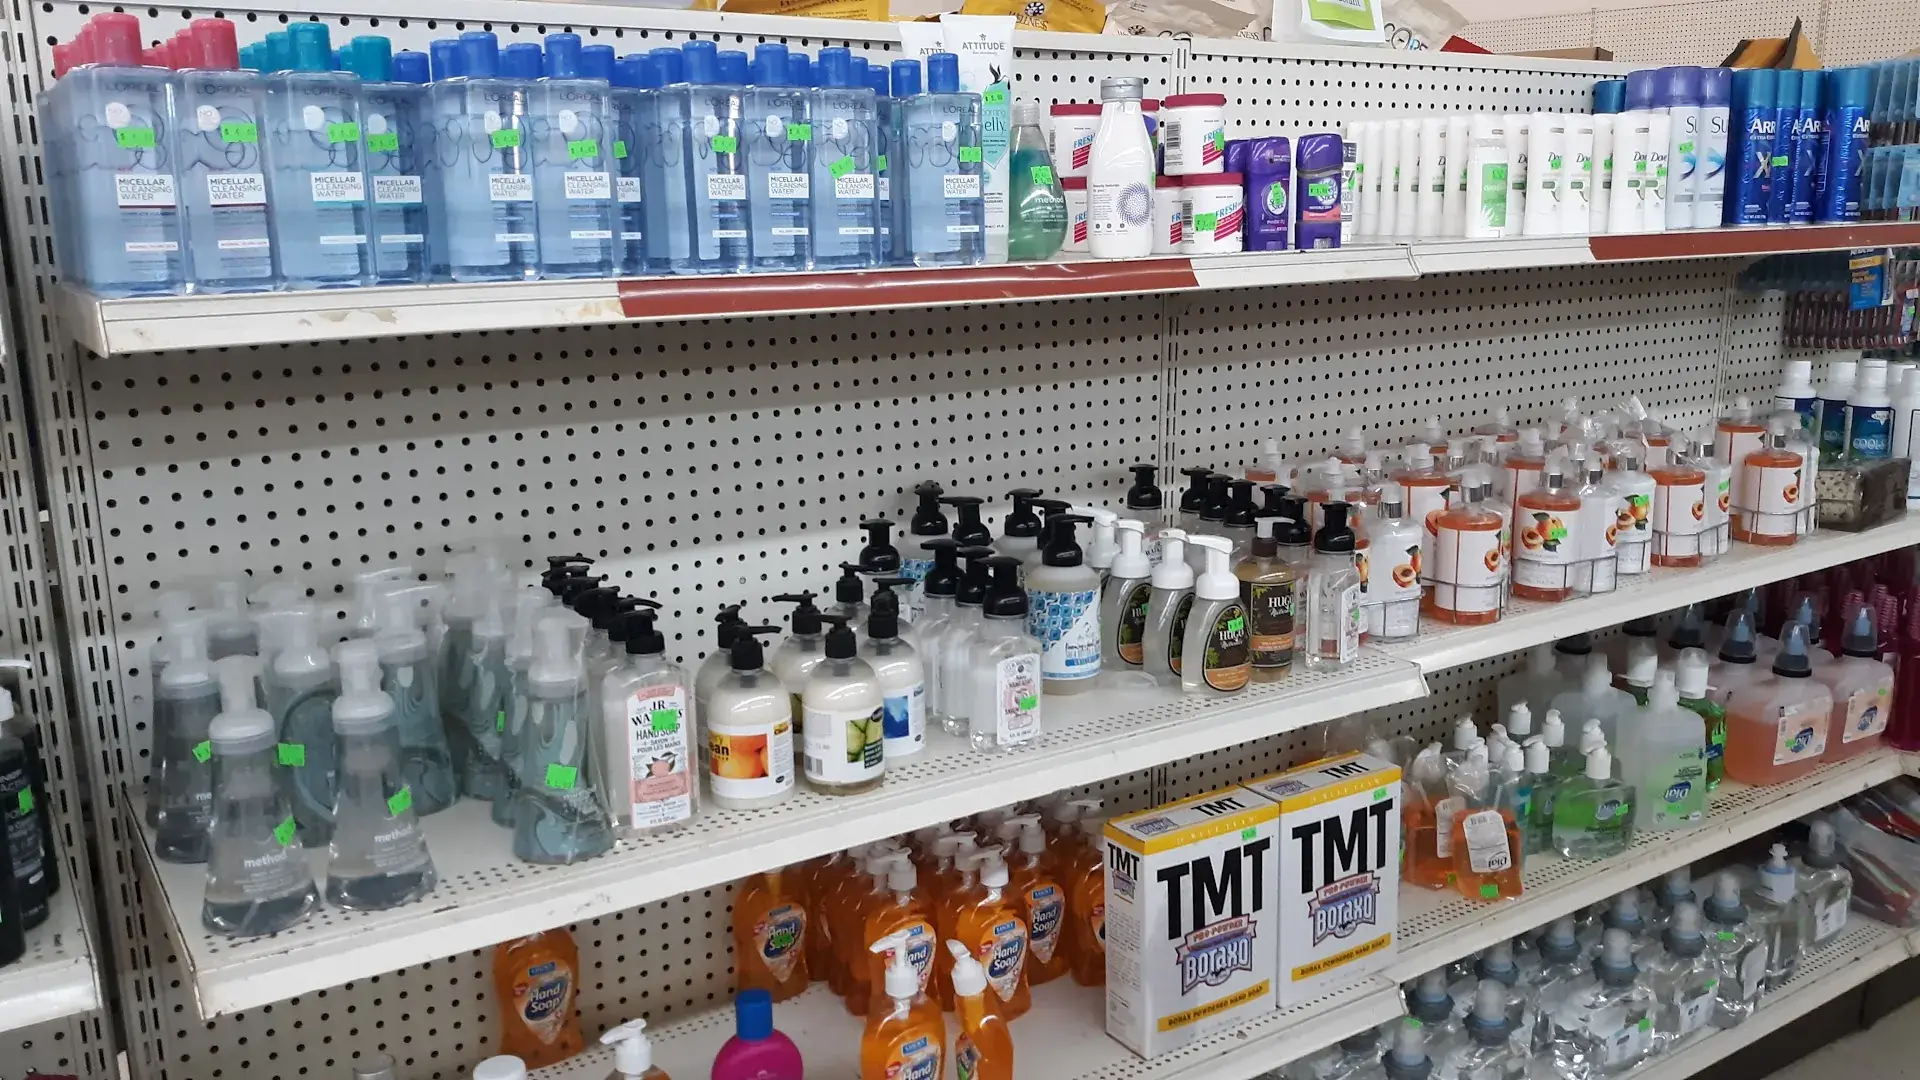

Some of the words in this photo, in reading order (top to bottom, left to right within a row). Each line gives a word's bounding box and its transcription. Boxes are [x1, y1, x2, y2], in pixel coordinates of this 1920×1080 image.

[962, 42, 1006, 51] ATTITUDE
[1751, 118, 1776, 133] ARR
[1633, 151, 1647, 161] Dov
[118, 178, 165, 186] MICELLAR
[210, 177, 256, 185] MICELLAR
[314, 176, 356, 184] MICELLAR
[315, 183, 361, 191] CLEANSING
[491, 177, 526, 185] MICELLAR
[770, 176, 804, 184] MICELLAR
[836, 177, 869, 185] MICELLAR
[211, 185, 262, 193] CLEANSING
[316, 190, 346, 198] WATER
[377, 186, 420, 194] CLEANSING
[492, 184, 531, 192] CLEANSING
[212, 192, 245, 200] WATER
[1219, 629, 1245, 642] HUGO
[709, 744, 729, 756] ean
[1319, 762, 1370, 778] TMT
[1664, 788, 1688, 800] Dial
[1191, 797, 1246, 816] TMT
[374, 824, 413, 843] method
[1292, 798, 1394, 894] TMT
[244, 850, 287, 868] method
[1107, 842, 1139, 881] TMT
[1488, 857, 1507, 868] Dial
[1156, 837, 1270, 940] TMT
[1032, 905, 1057, 923] Hand
[768, 922, 796, 940] Hand
[1032, 919, 1056, 934] Soap
[1193, 919, 1243, 942] PRO-POWDER
[907, 945, 927, 963] and
[994, 942, 1019, 960] Hand
[993, 955, 1018, 971] Soap
[530, 983, 561, 1002] Hand
[530, 998, 561, 1014] Soap
[904, 1060, 932, 1080] Hand
